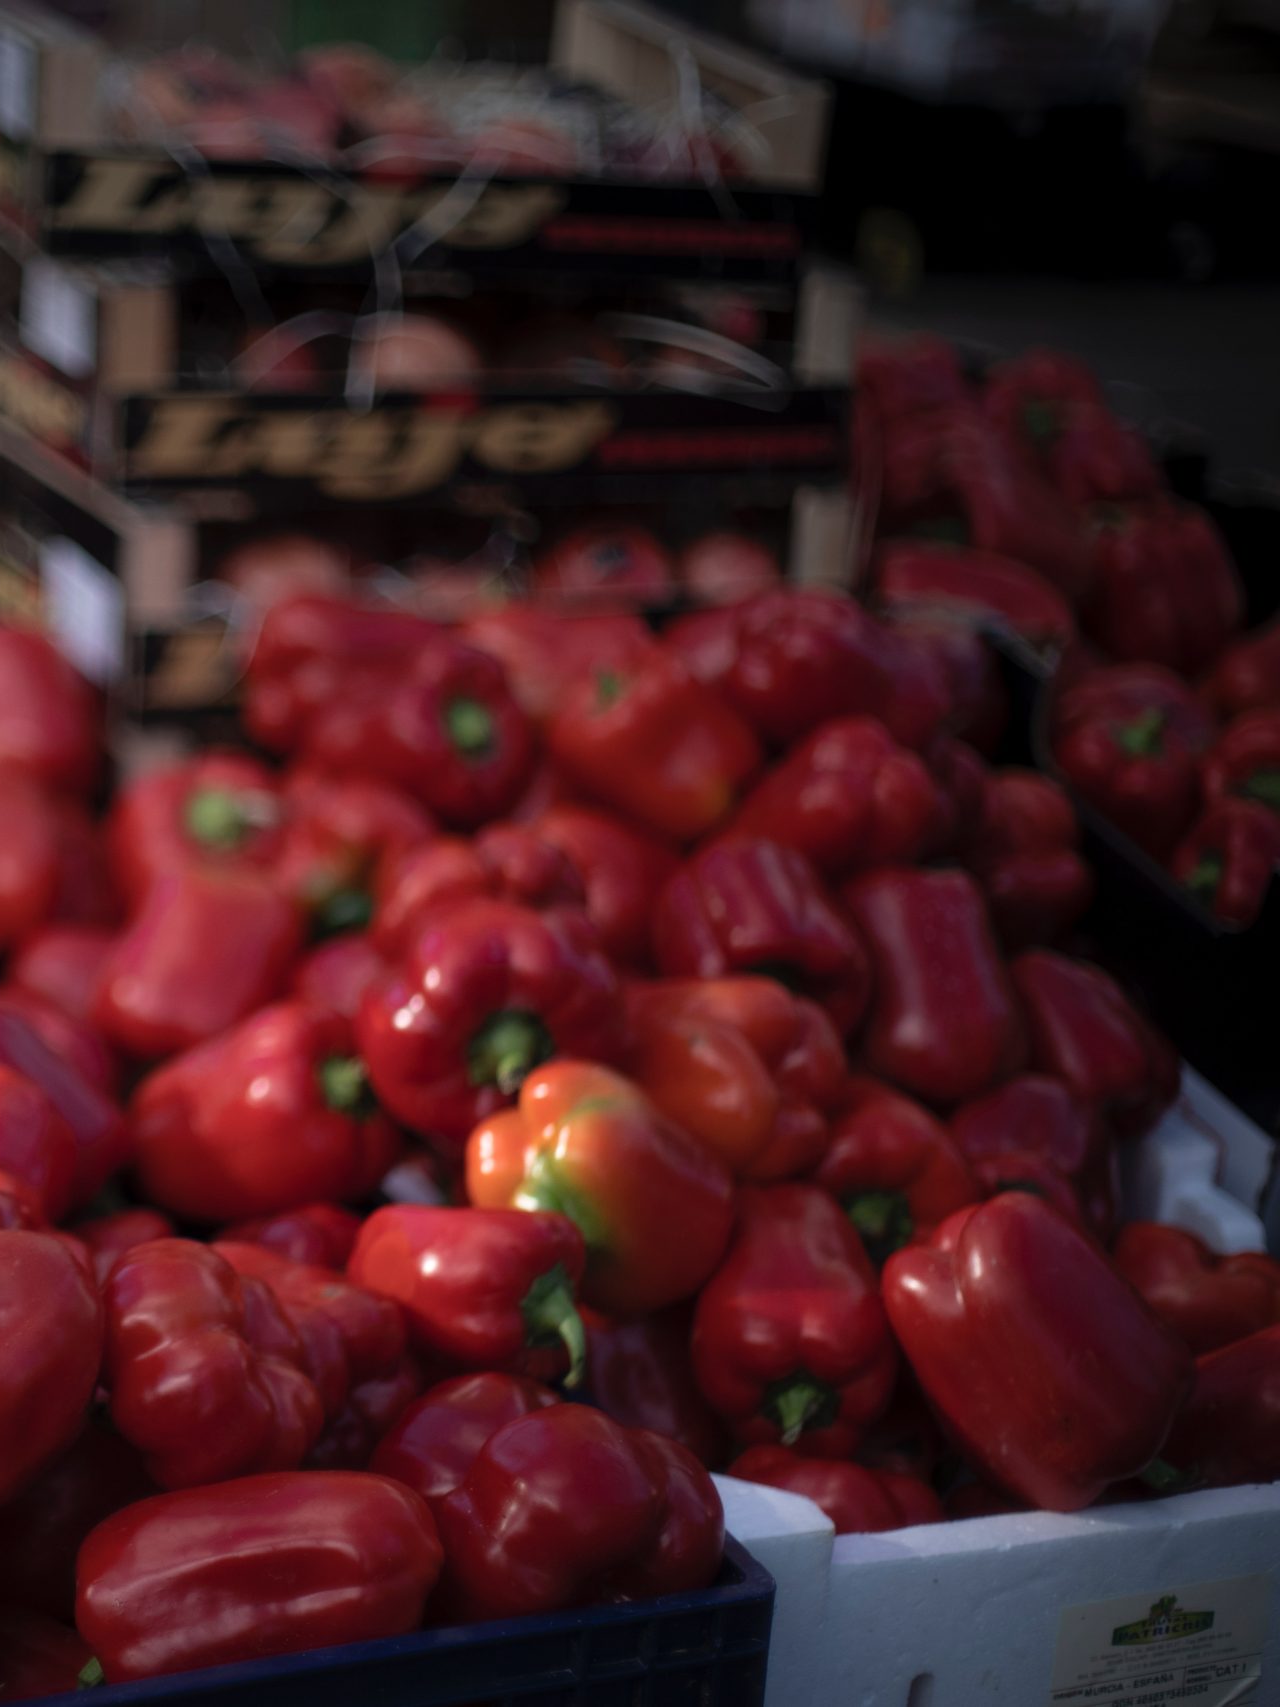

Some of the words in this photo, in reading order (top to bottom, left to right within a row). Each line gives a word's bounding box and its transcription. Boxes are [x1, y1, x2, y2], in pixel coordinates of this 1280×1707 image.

[1216, 1664, 1238, 1677] CAT
[1084, 1683, 1124, 1697] MURCIA
[1133, 1673, 1174, 1689] ESPAÑA
